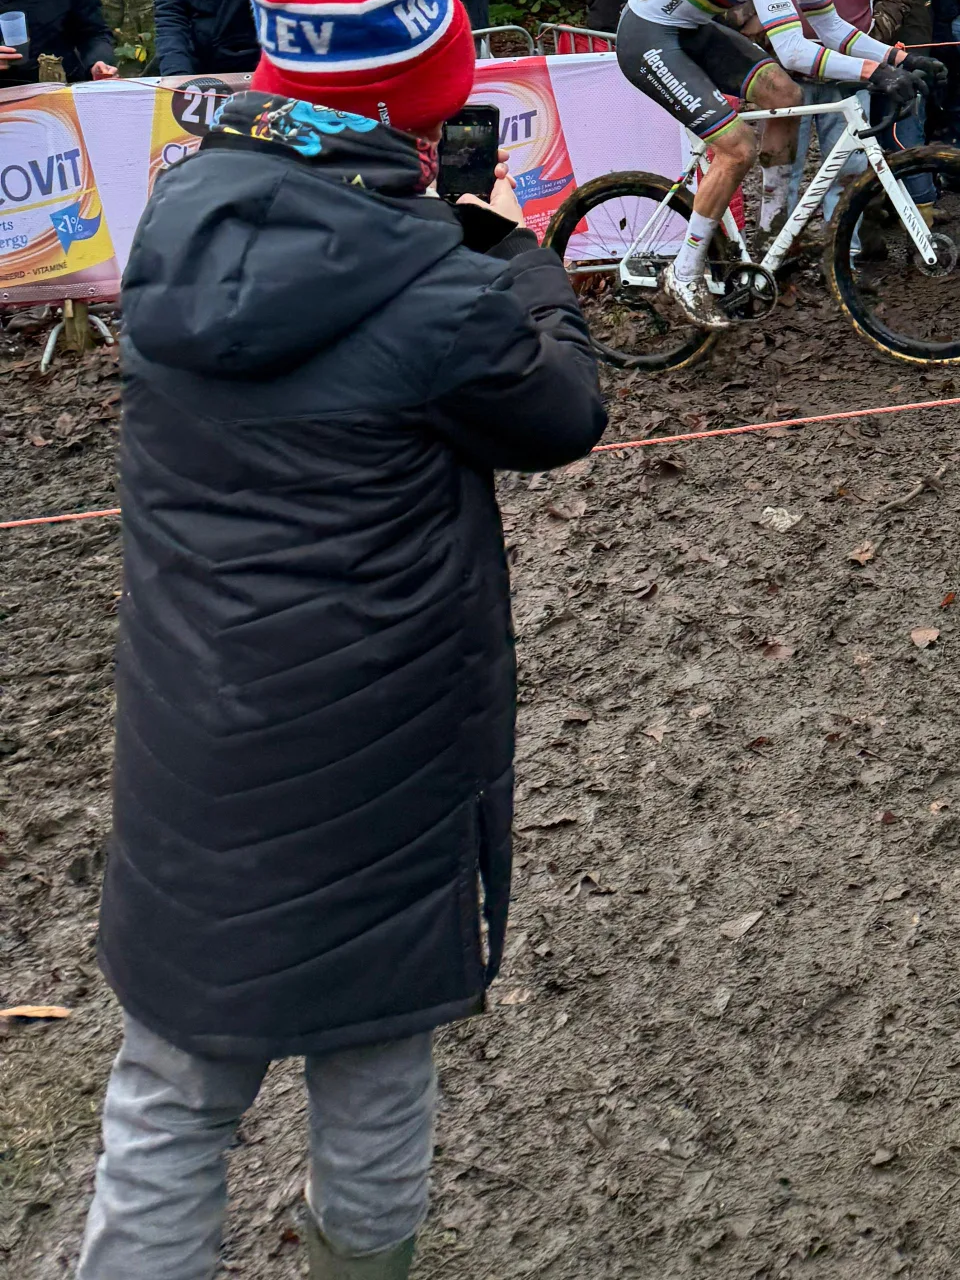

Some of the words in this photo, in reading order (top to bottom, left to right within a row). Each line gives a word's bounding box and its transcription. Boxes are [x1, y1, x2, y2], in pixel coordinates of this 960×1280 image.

[181, 84, 217, 125] 21
[643, 48, 702, 113] deceuninck
[646, 73, 675, 104] WINDOWS
[0, 147, 81, 206] OVIT
[793, 150, 851, 221] CANYON
